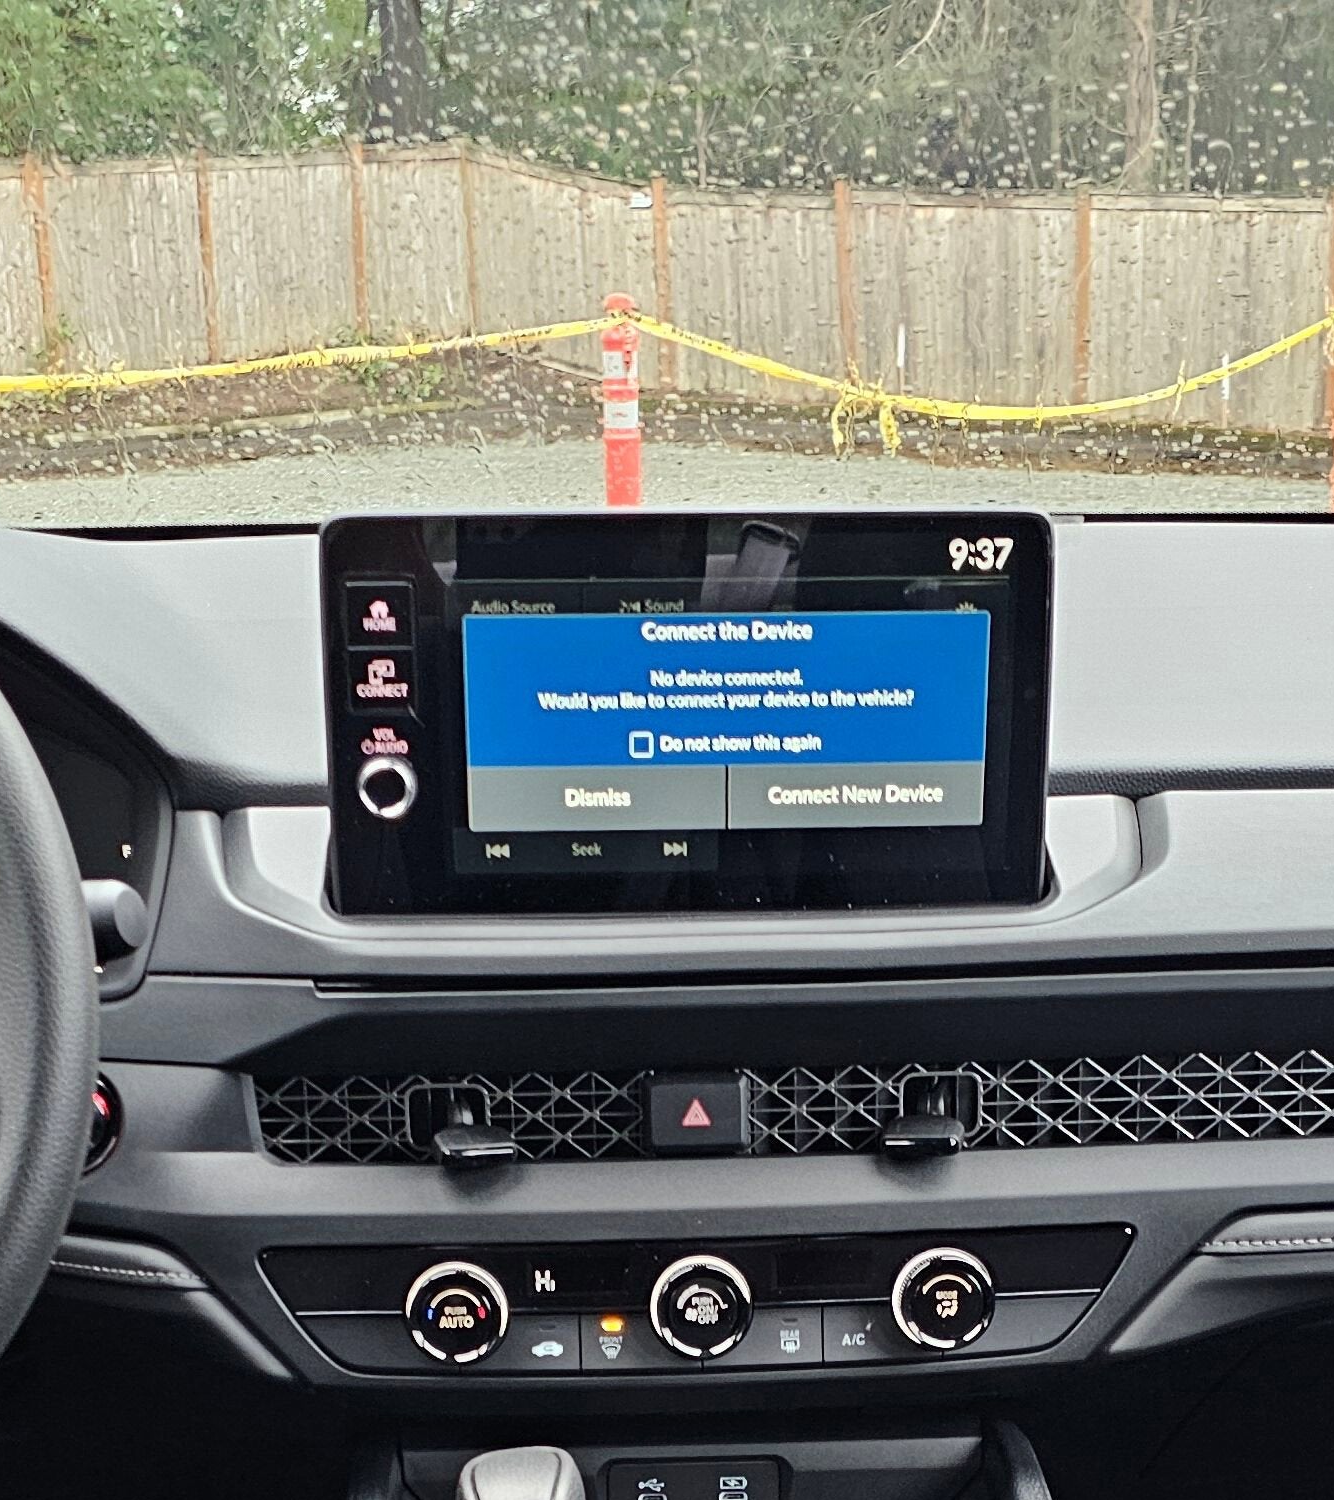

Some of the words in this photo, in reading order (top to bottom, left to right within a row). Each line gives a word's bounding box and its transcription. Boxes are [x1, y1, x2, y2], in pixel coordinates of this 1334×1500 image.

[948, 537, 1014, 571] 9:37
[470, 600, 509, 615] Audio
[511, 599, 556, 614] Source
[643, 598, 685, 613] Sound
[640, 621, 717, 642] Connect
[718, 620, 750, 641] the
[751, 620, 814, 641] Device
[649, 670, 674, 687] No
[674, 668, 723, 687] device
[723, 668, 804, 687] connected.
[356, 682, 409, 698] CONNECT
[536, 691, 589, 710] Would
[588, 696, 619, 713] you
[619, 691, 646, 710] like
[647, 693, 666, 710] to
[666, 692, 726, 710] connect
[726, 692, 762, 711] your
[762, 689, 811, 708] device
[811, 691, 829, 708] to
[830, 689, 856, 707] the
[856, 688, 915, 707] vehicle?
[374, 740, 409, 754] AUDIO
[659, 734, 684, 753] Do
[684, 735, 711, 753] not
[711, 734, 752, 752] show
[752, 733, 782, 752] this
[782, 733, 822, 754] again
[564, 787, 632, 808] Dismiss
[767, 785, 840, 805] Connect
[842, 784, 883, 804] New
[885, 783, 944, 803] Device
[121, 844, 132, 859] F
[571, 841, 603, 858] Seek
[438, 1314, 475, 1329] AUTO
[598, 1335, 624, 1345] FRONT
[841, 1332, 866, 1347] A/C
